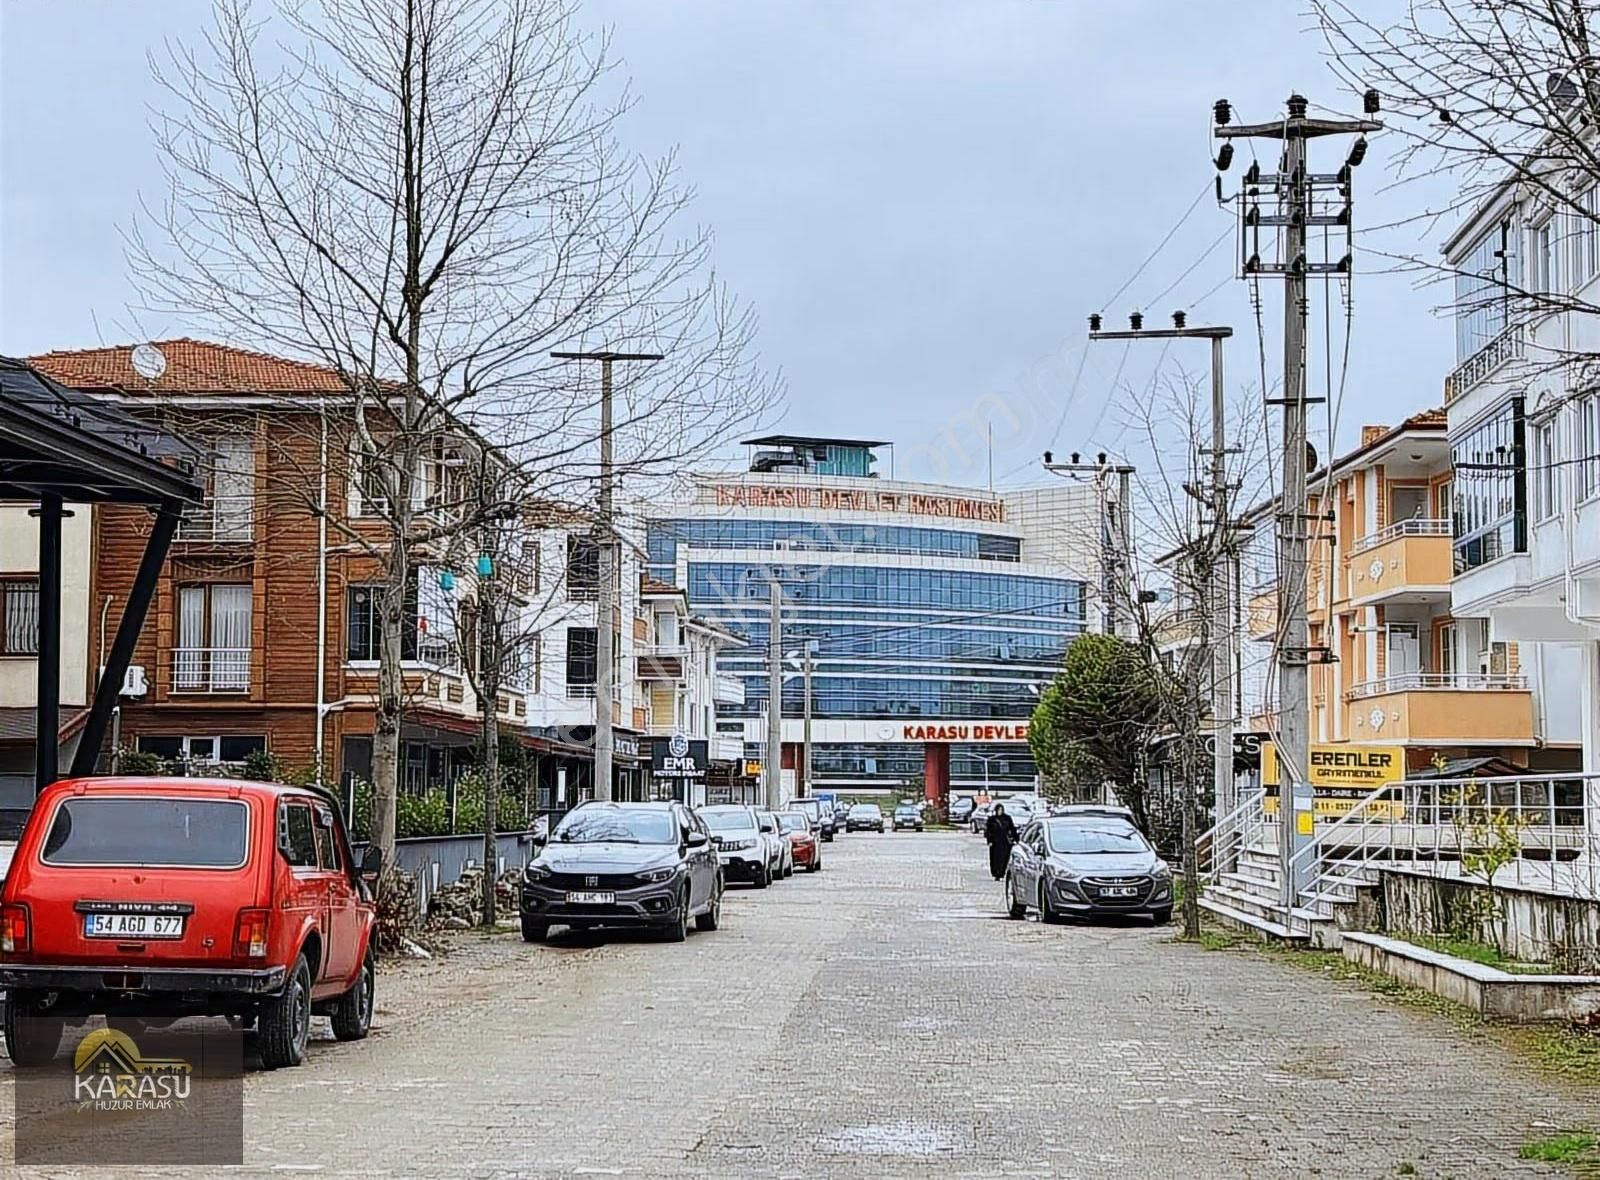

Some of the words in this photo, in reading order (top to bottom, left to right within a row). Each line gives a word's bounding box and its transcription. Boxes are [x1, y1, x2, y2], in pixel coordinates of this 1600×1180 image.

[716, 485, 811, 508] KARASU
[820, 487, 901, 513] DEVLET
[904, 725, 969, 740] KARASU
[663, 757, 696, 770] EMR
[1311, 751, 1392, 768] ERENLER
[95, 916, 113, 932] 54
[119, 917, 146, 932] AGD
[153, 917, 181, 933] 677
